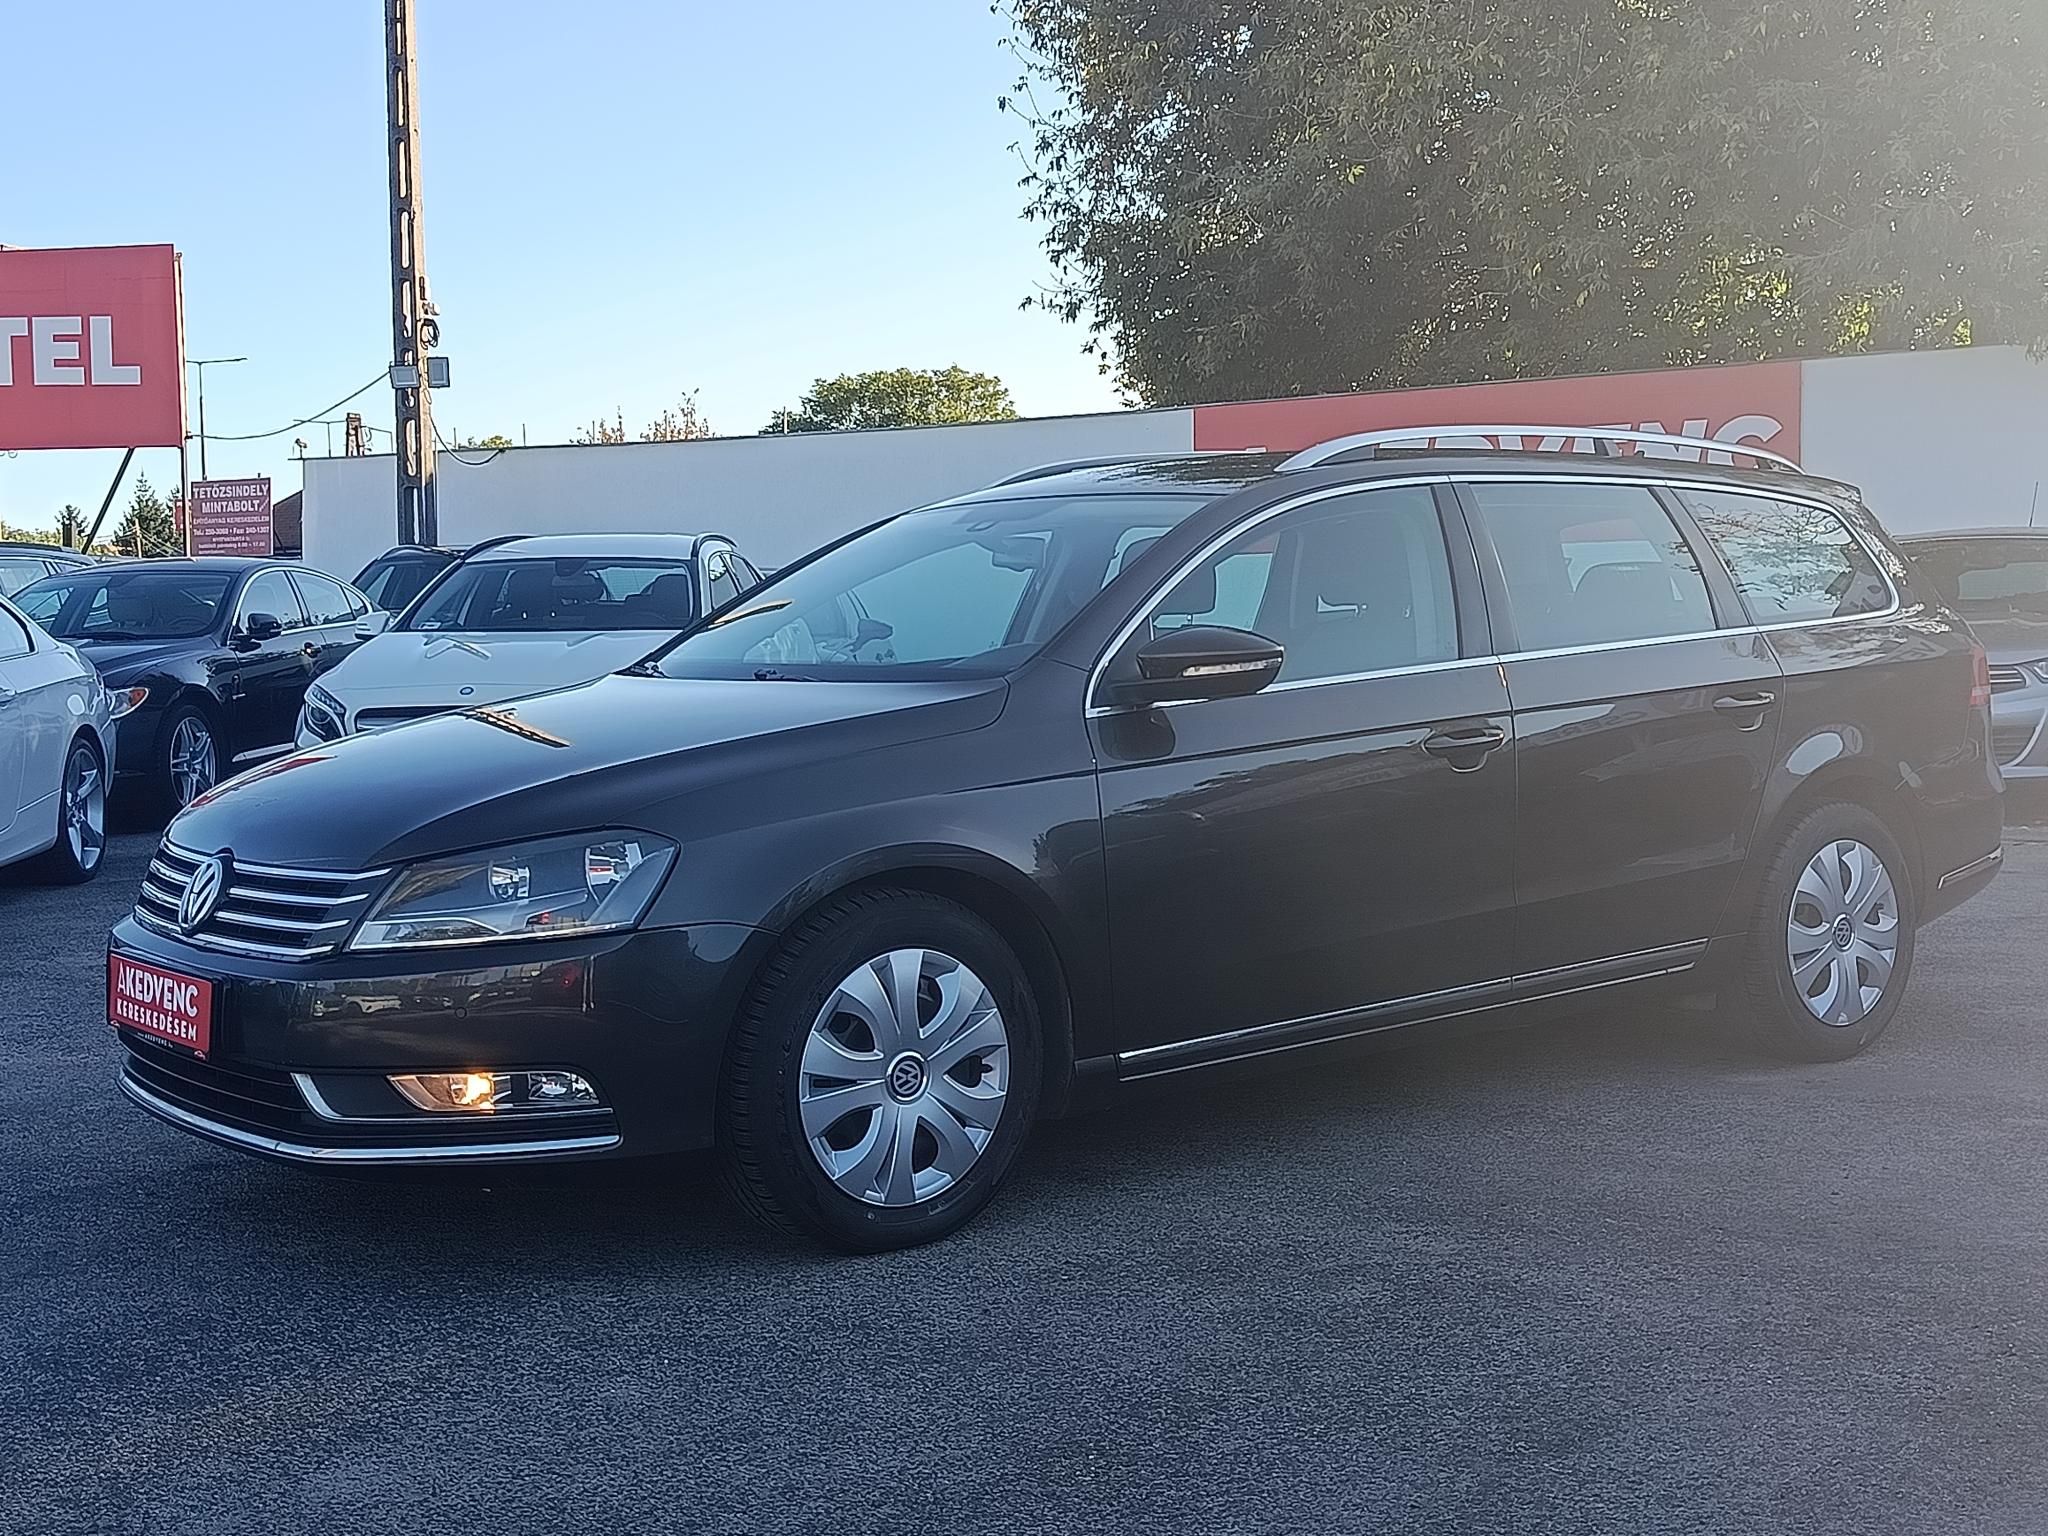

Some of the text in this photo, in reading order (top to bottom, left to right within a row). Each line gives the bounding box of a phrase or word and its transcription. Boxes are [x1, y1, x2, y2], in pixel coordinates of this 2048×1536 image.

[193, 484, 269, 499] TETŐZSINDELY
[202, 500, 260, 513] MINTABOLT
[117, 961, 198, 1017] AKEDVENC
[116, 998, 198, 1042] KERESKEDÉSEM
